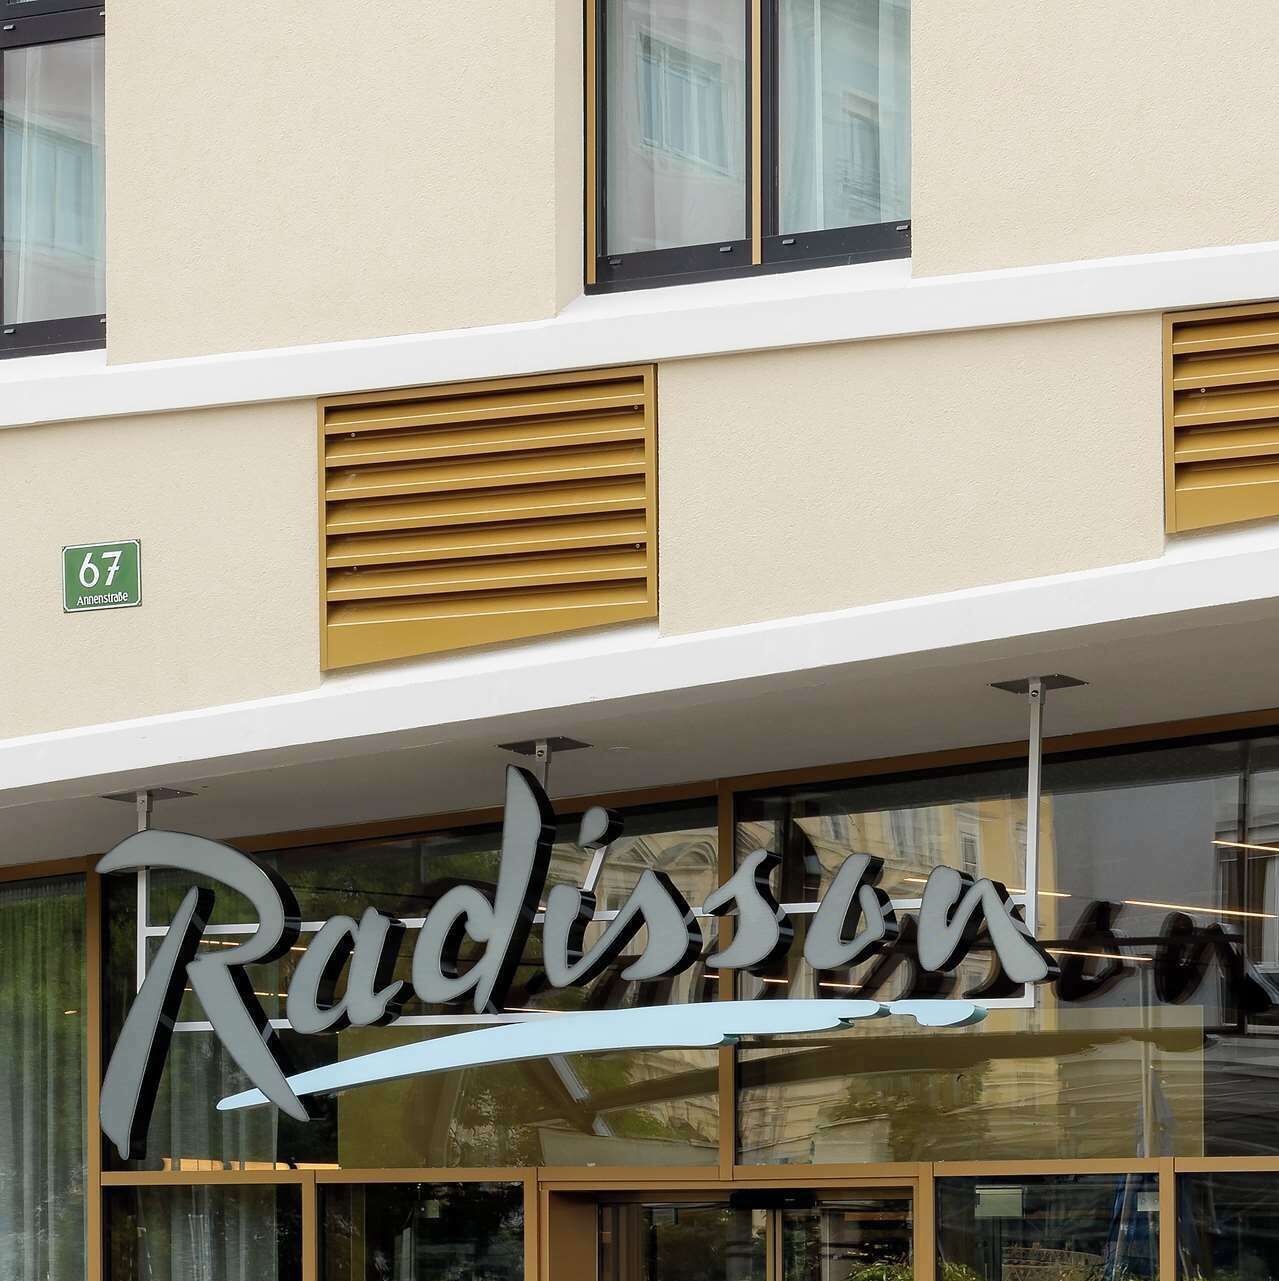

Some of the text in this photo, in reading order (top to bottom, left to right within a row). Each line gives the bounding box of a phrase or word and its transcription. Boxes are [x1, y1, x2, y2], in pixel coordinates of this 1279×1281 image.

[79, 550, 123, 588] 67
[76, 591, 129, 606] Annenstraße
[95, 764, 1056, 1160] Radisson
